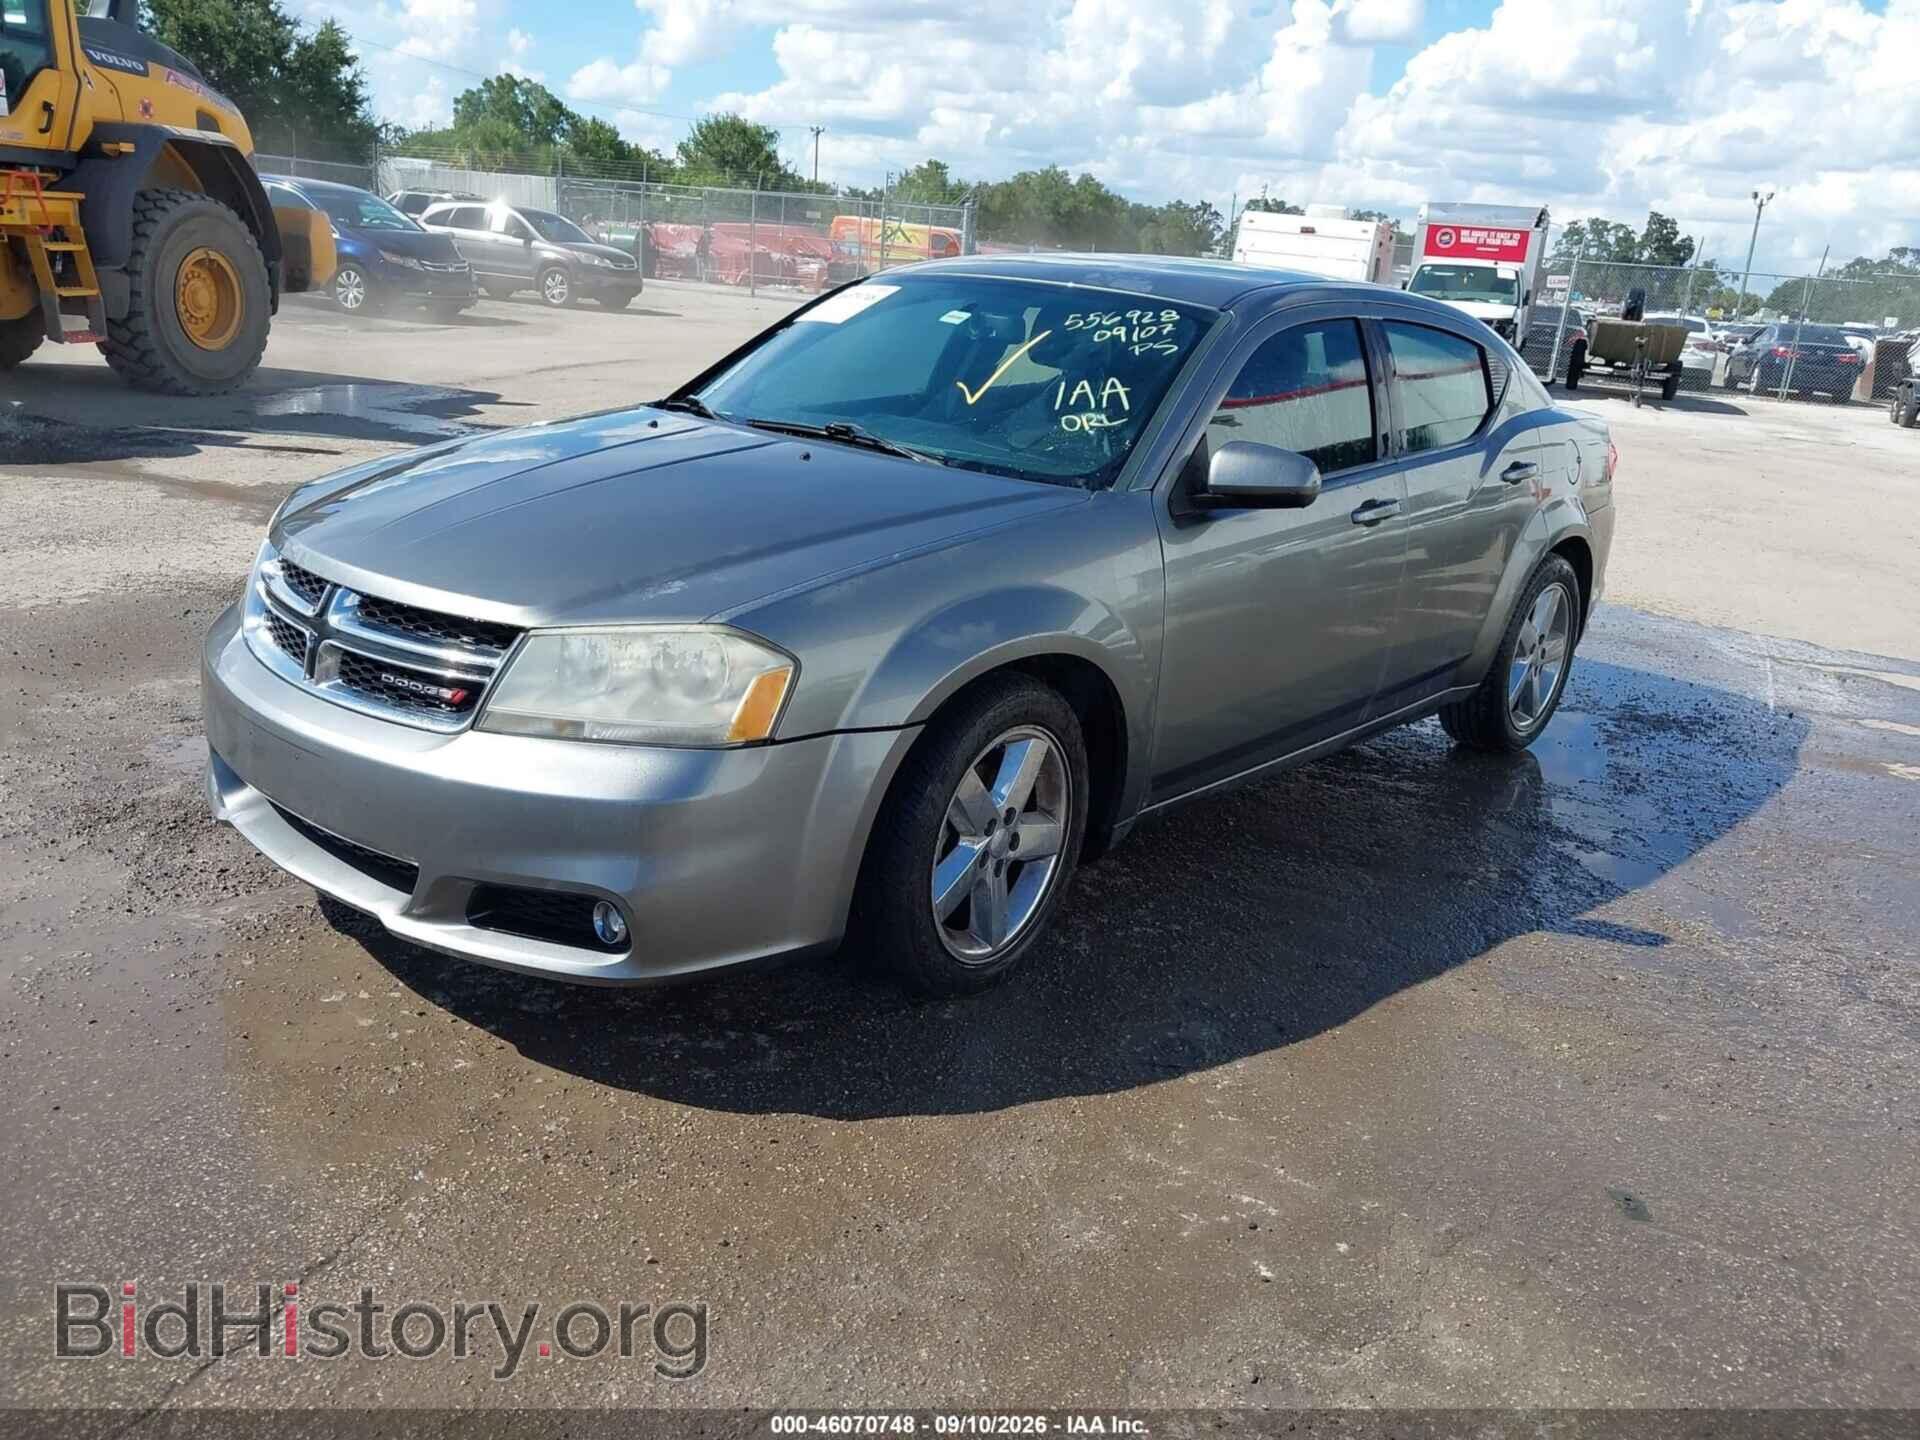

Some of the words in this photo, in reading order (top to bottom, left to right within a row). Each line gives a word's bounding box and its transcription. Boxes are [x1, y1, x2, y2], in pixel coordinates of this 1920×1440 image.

[86, 49, 144, 71] VOLVO
[1063, 308, 1181, 331] 556928
[1054, 377, 1132, 411] IAA
[381, 673, 453, 700] DODGE
